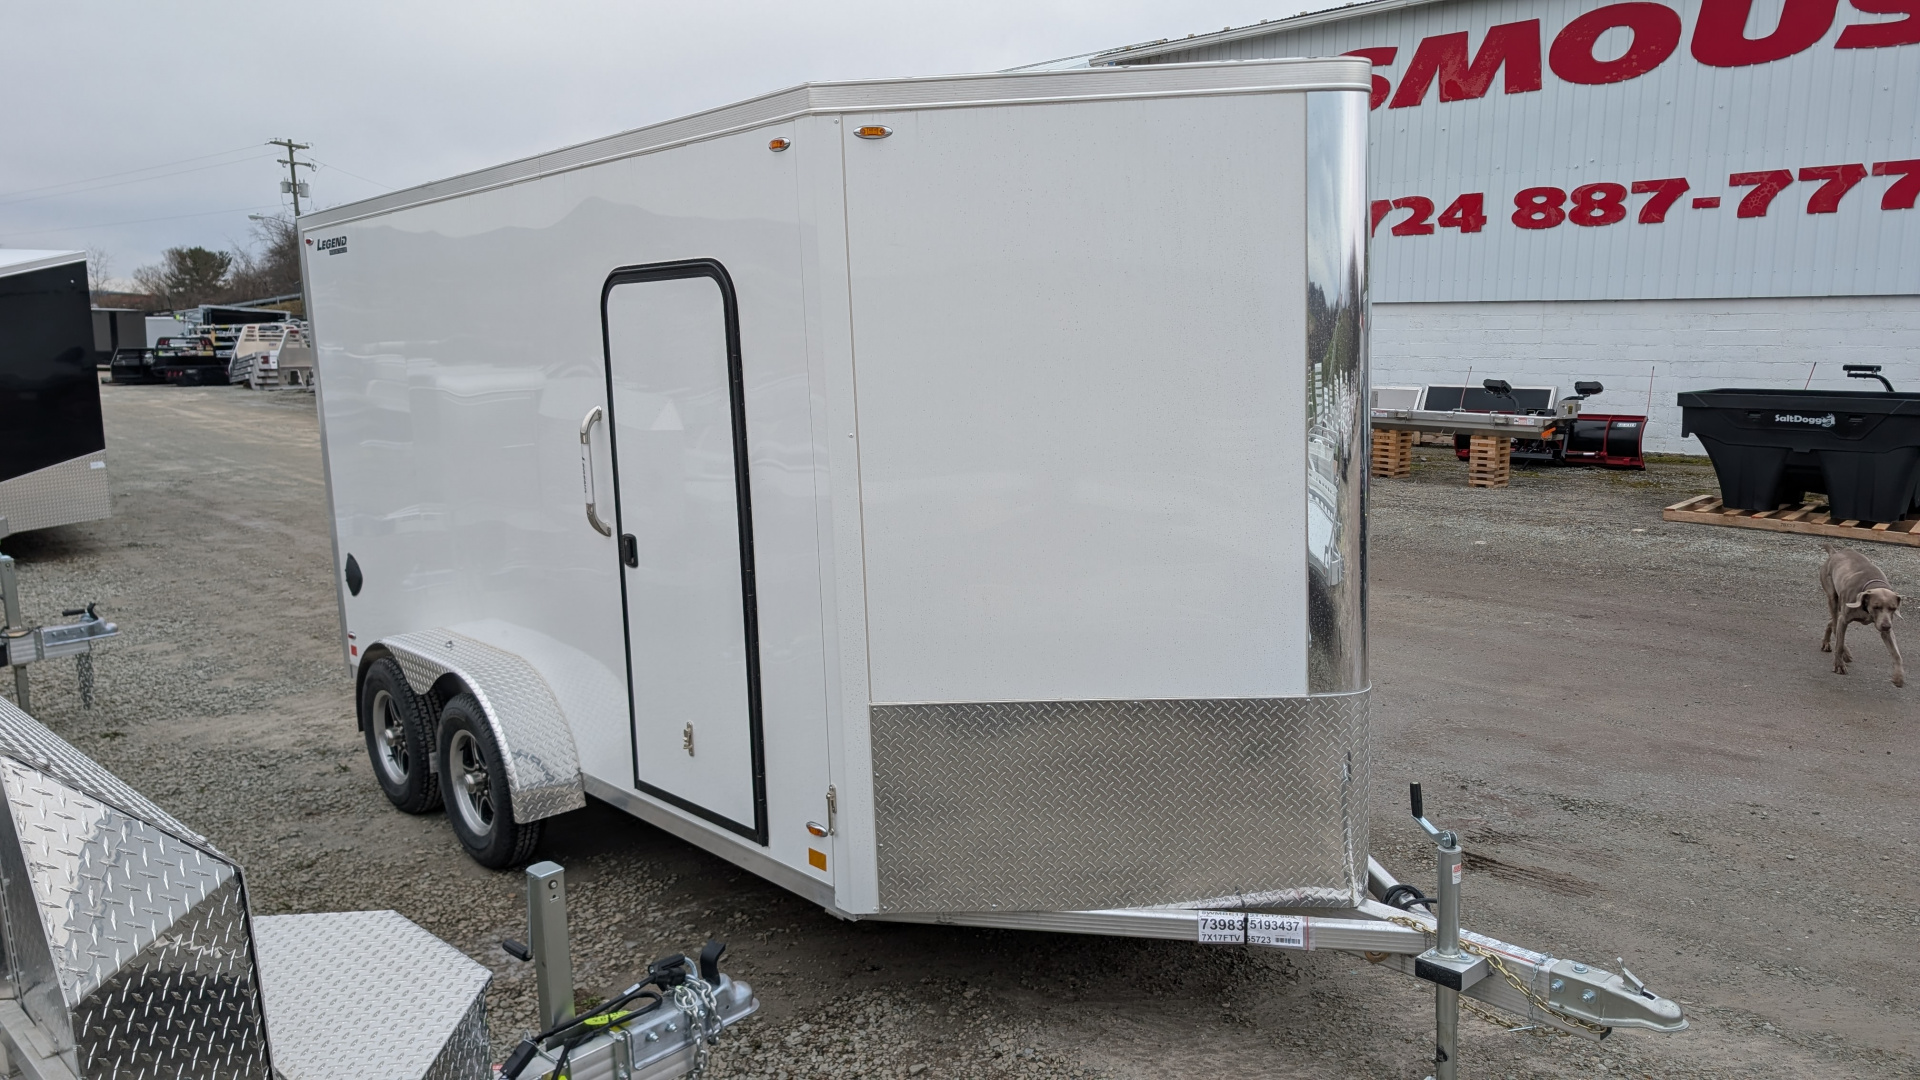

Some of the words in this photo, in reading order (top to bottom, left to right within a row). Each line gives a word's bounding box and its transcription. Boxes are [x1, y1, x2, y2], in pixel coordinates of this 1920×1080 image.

[317, 236, 347, 251] LEGEND
[1201, 918, 1244, 931] 73983
[1250, 919, 1300, 931] 5193437
[1202, 934, 1241, 942] 7X17FTV
